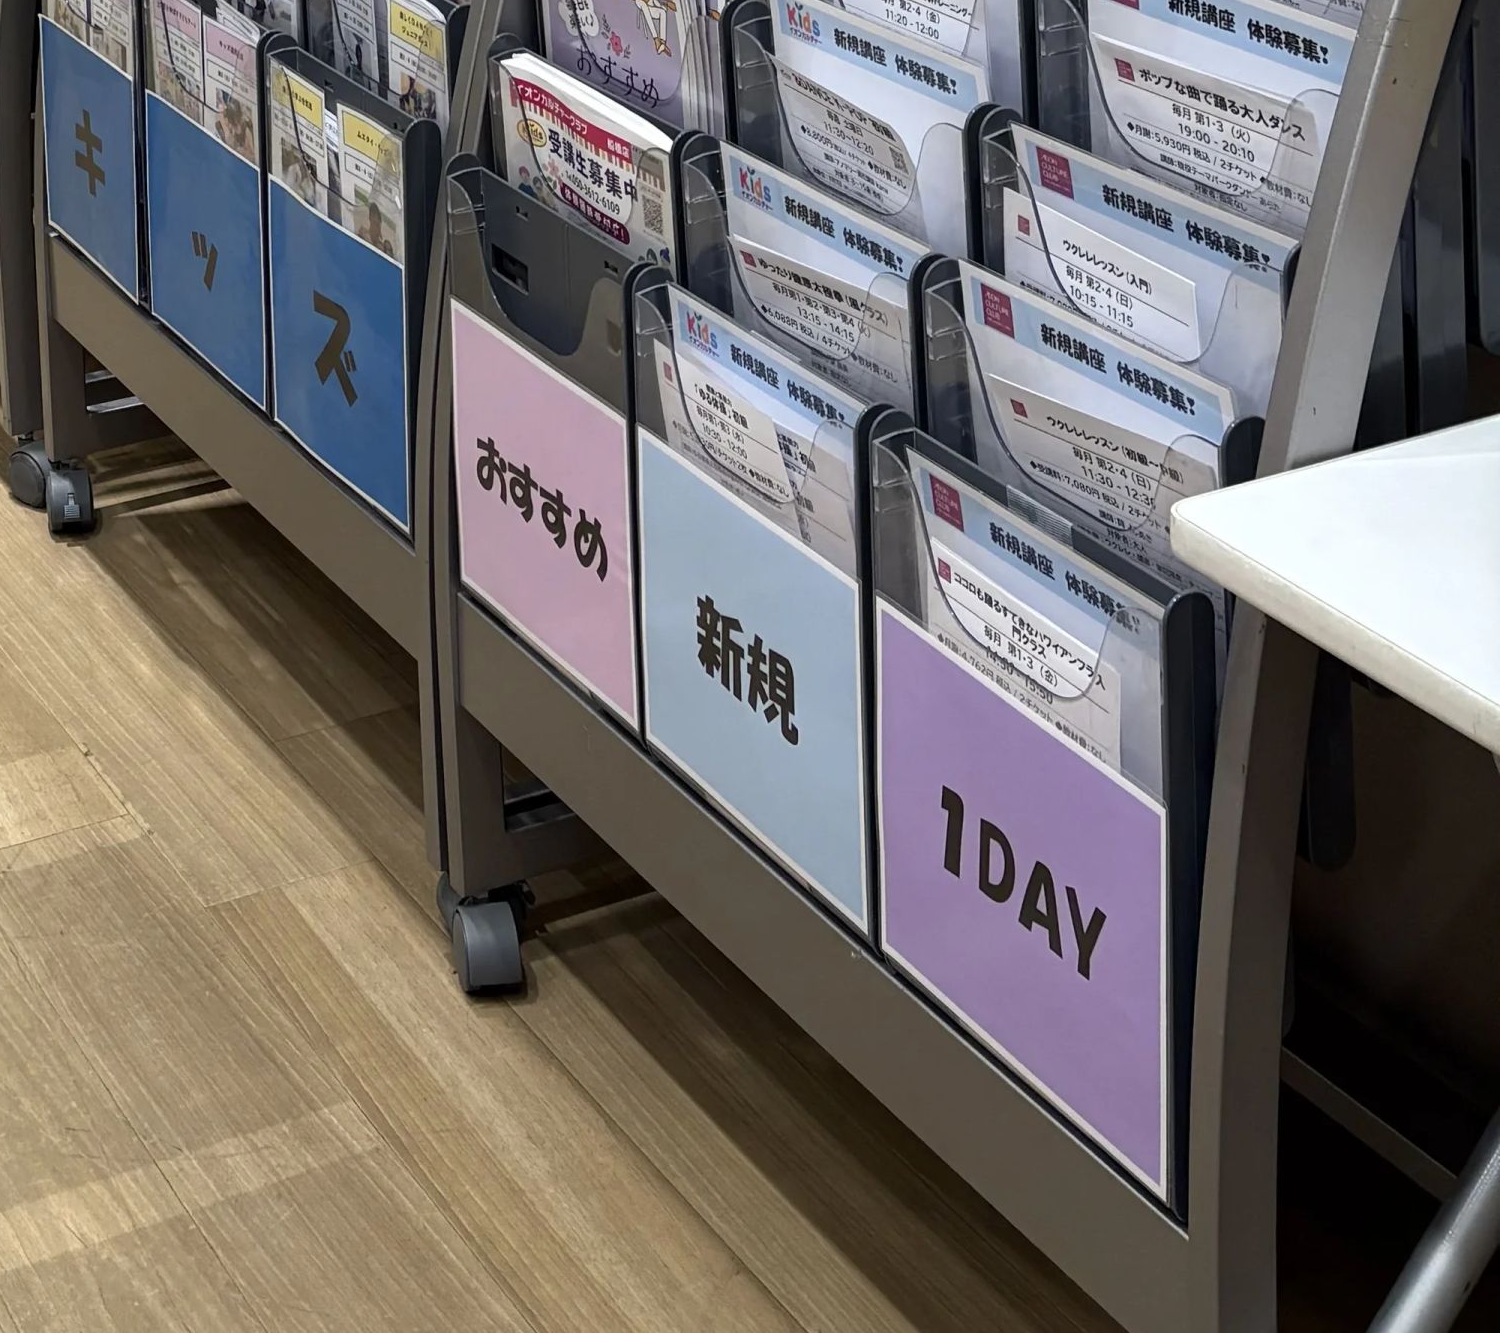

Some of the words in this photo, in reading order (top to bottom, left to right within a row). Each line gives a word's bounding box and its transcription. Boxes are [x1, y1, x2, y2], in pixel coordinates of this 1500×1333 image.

[834, 28, 887, 67] 新規講座
[885, 8, 908, 26] 11:20
[915, 22, 940, 39] 12:00
[1247, 18, 1329, 65] 体験募集!
[577, 44, 659, 108] おすすめ
[1138, 68, 1306, 141] ポップな曲で踊る大人ダンス
[548, 128, 639, 202] 受講生募集中
[1178, 122, 1211, 144] 19:00
[1221, 140, 1255, 163] 20:10
[784, 195, 835, 238] 新規講座
[1102, 183, 1174, 233] 新規講座
[687, 312, 718, 349] Kids
[1070, 285, 1098, 309] 10:15
[1106, 302, 1134, 328] 11:15
[730, 344, 780, 389] 新規講座
[1040, 323, 1107, 375] 新規講座
[474, 434, 610, 583] おすすめ
[990, 522, 1056, 581] 新規講座
[694, 592, 800, 748] 新規
[937, 783, 1109, 981] 1DAY
